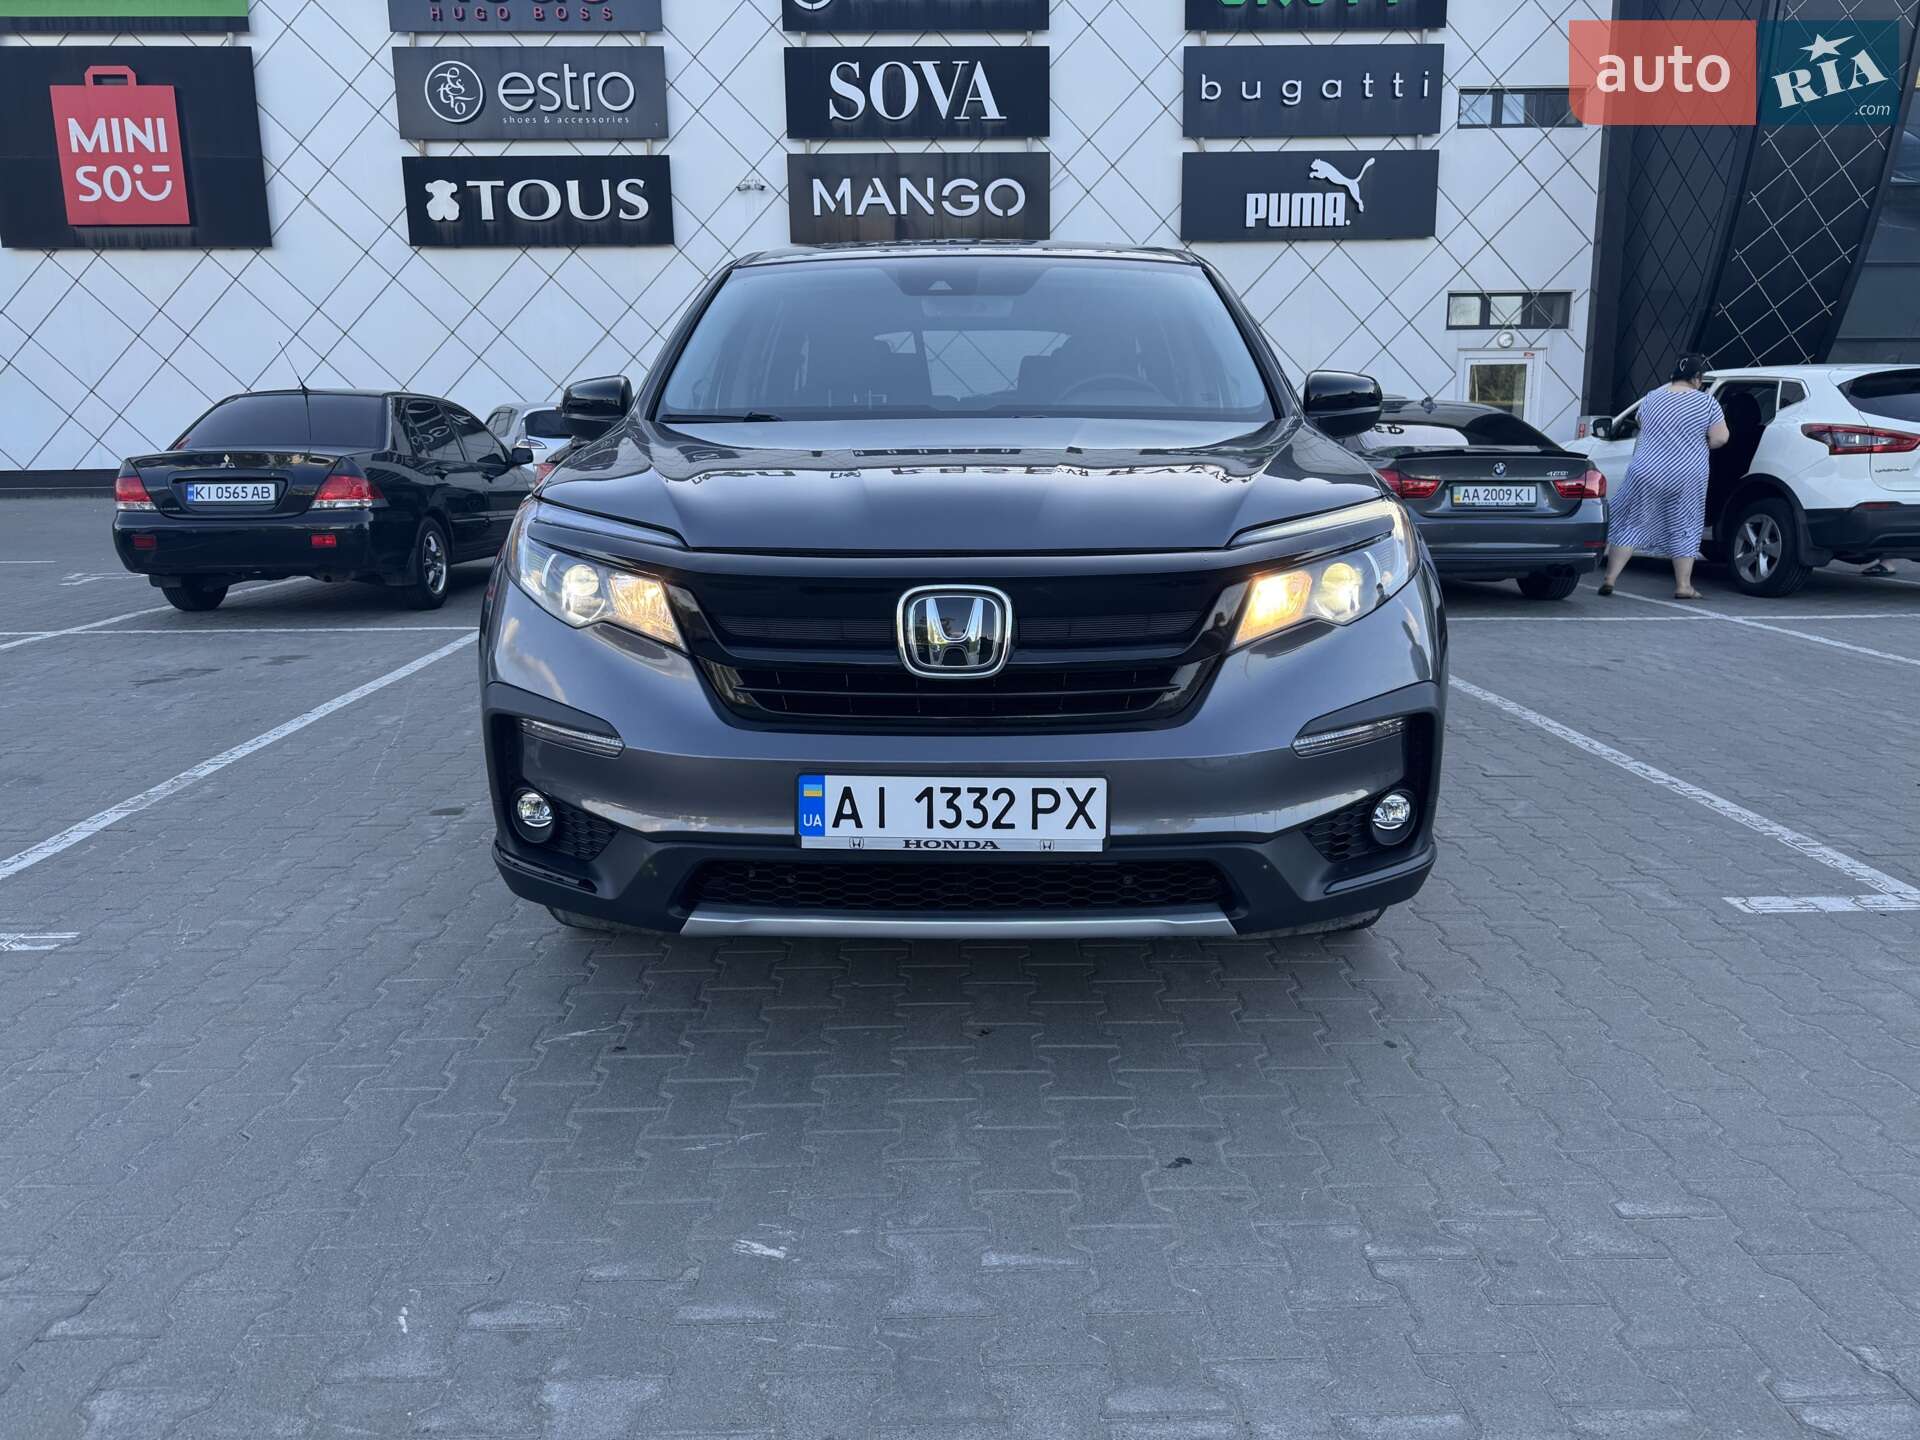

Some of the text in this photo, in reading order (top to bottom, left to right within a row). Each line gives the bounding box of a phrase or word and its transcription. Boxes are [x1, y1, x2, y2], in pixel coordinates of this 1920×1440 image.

[429, 6, 613, 20] HUGO BOSS
[497, 63, 635, 112] estro
[829, 60, 1007, 121] SOVA
[1201, 70, 1430, 106] bugatti
[67, 117, 168, 153] MINI
[502, 115, 630, 124] shoes & accessories
[466, 178, 649, 221] TOUS
[812, 177, 1026, 217] MANGO
[195, 486, 271, 500] KI 0565 AB
[1462, 488, 1530, 501] AA 2009 KI
[803, 813, 823, 828] UA
[831, 786, 1097, 830] AI 1332 PX
[902, 839, 1000, 850] HONDA
